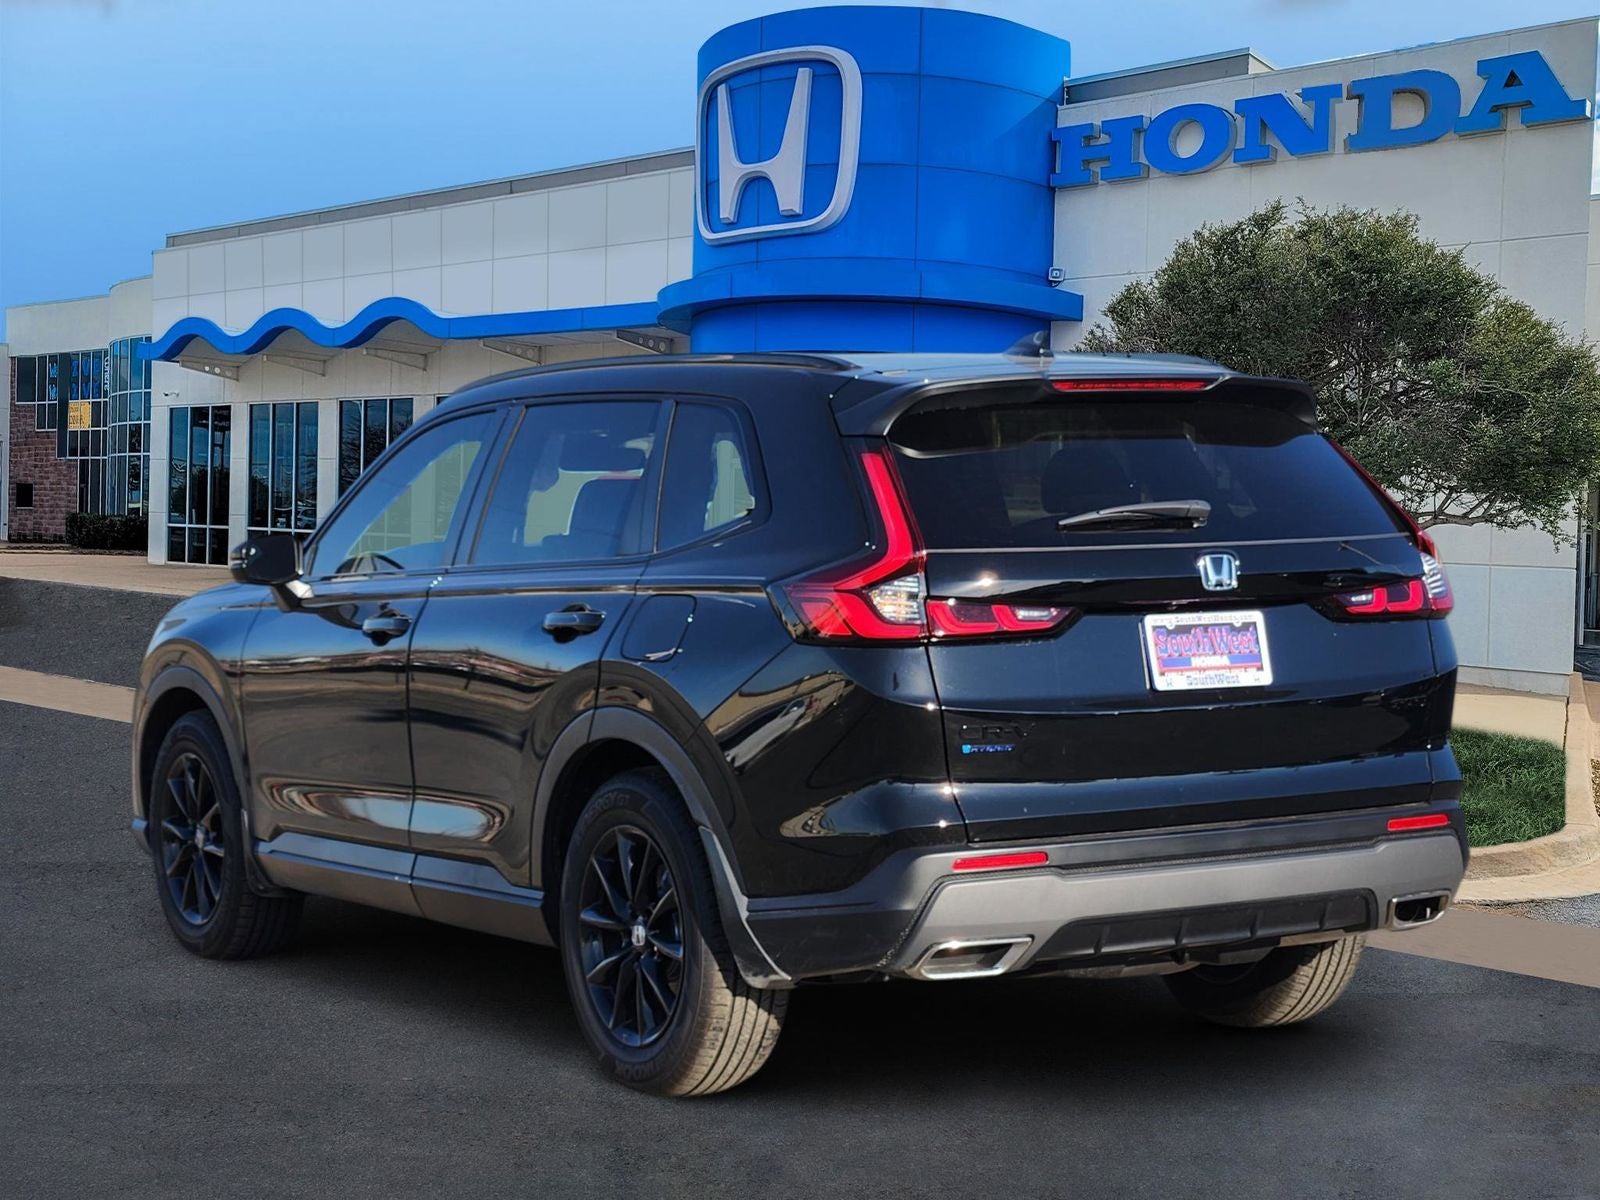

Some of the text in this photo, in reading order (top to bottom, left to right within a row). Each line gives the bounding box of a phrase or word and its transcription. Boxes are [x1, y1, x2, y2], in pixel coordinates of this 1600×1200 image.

[1050, 50, 1590, 188] HONDA
[1153, 623, 1260, 657] SouthWest
[1186, 673, 1241, 687] SouthWest
